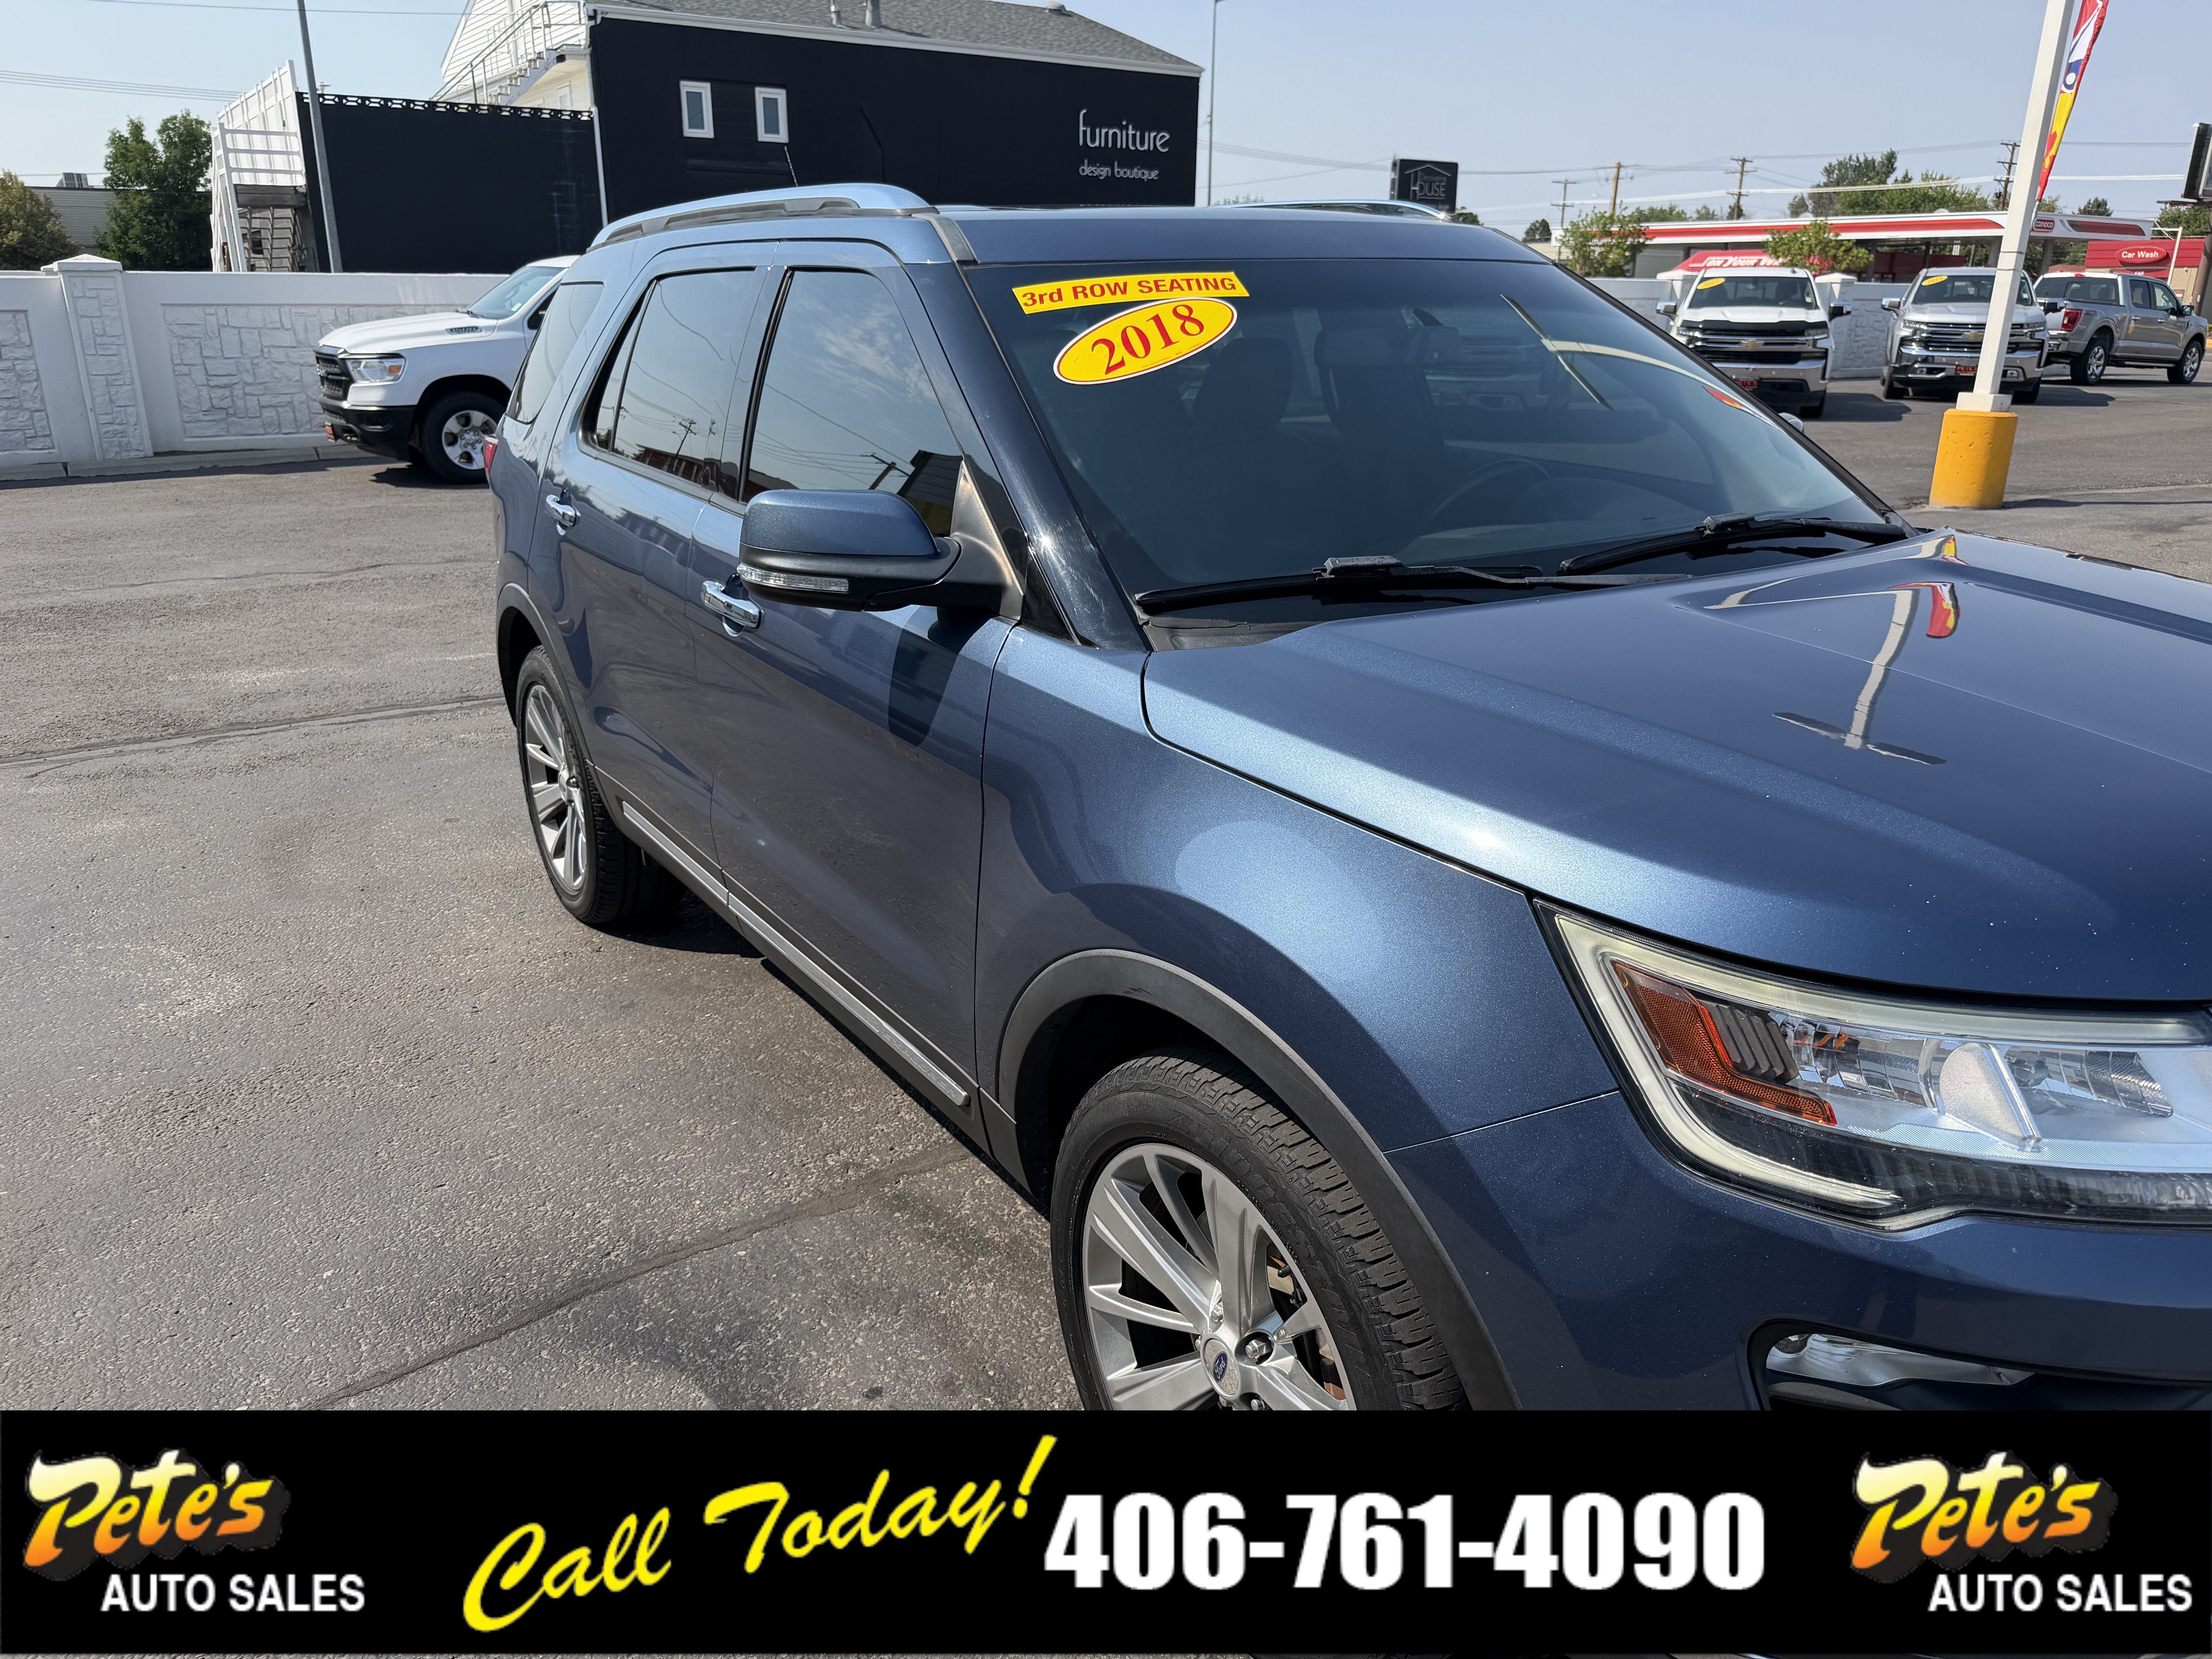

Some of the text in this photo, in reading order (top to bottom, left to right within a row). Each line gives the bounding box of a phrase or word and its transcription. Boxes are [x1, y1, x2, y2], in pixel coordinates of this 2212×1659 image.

[1079, 108, 1170, 152] furniture
[1079, 158, 1159, 182] design boutique
[1022, 278, 1236, 306] 3rd ROW SEATING
[1091, 304, 1204, 375] 2018
[1214, 1356, 1225, 1379] Ford
